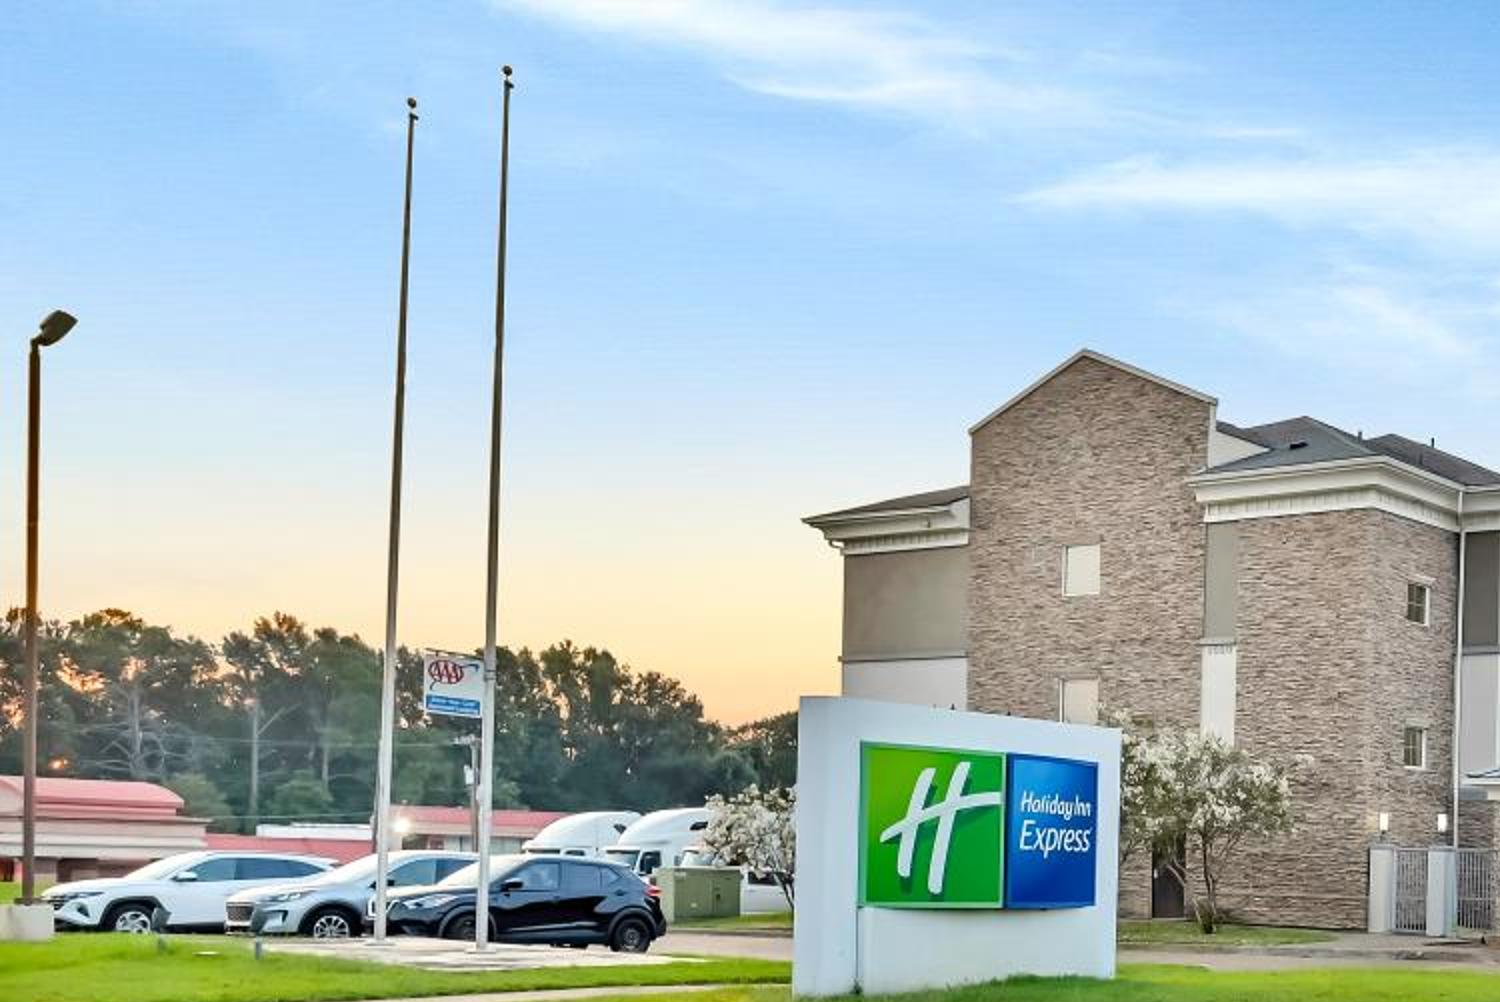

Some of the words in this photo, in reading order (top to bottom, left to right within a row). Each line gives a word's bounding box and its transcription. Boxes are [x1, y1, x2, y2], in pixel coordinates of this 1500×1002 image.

[430, 659, 462, 684] AAA
[1020, 790, 1072, 821] Holiday
[1073, 795, 1092, 816] Inn
[1019, 819, 1091, 859] Express
